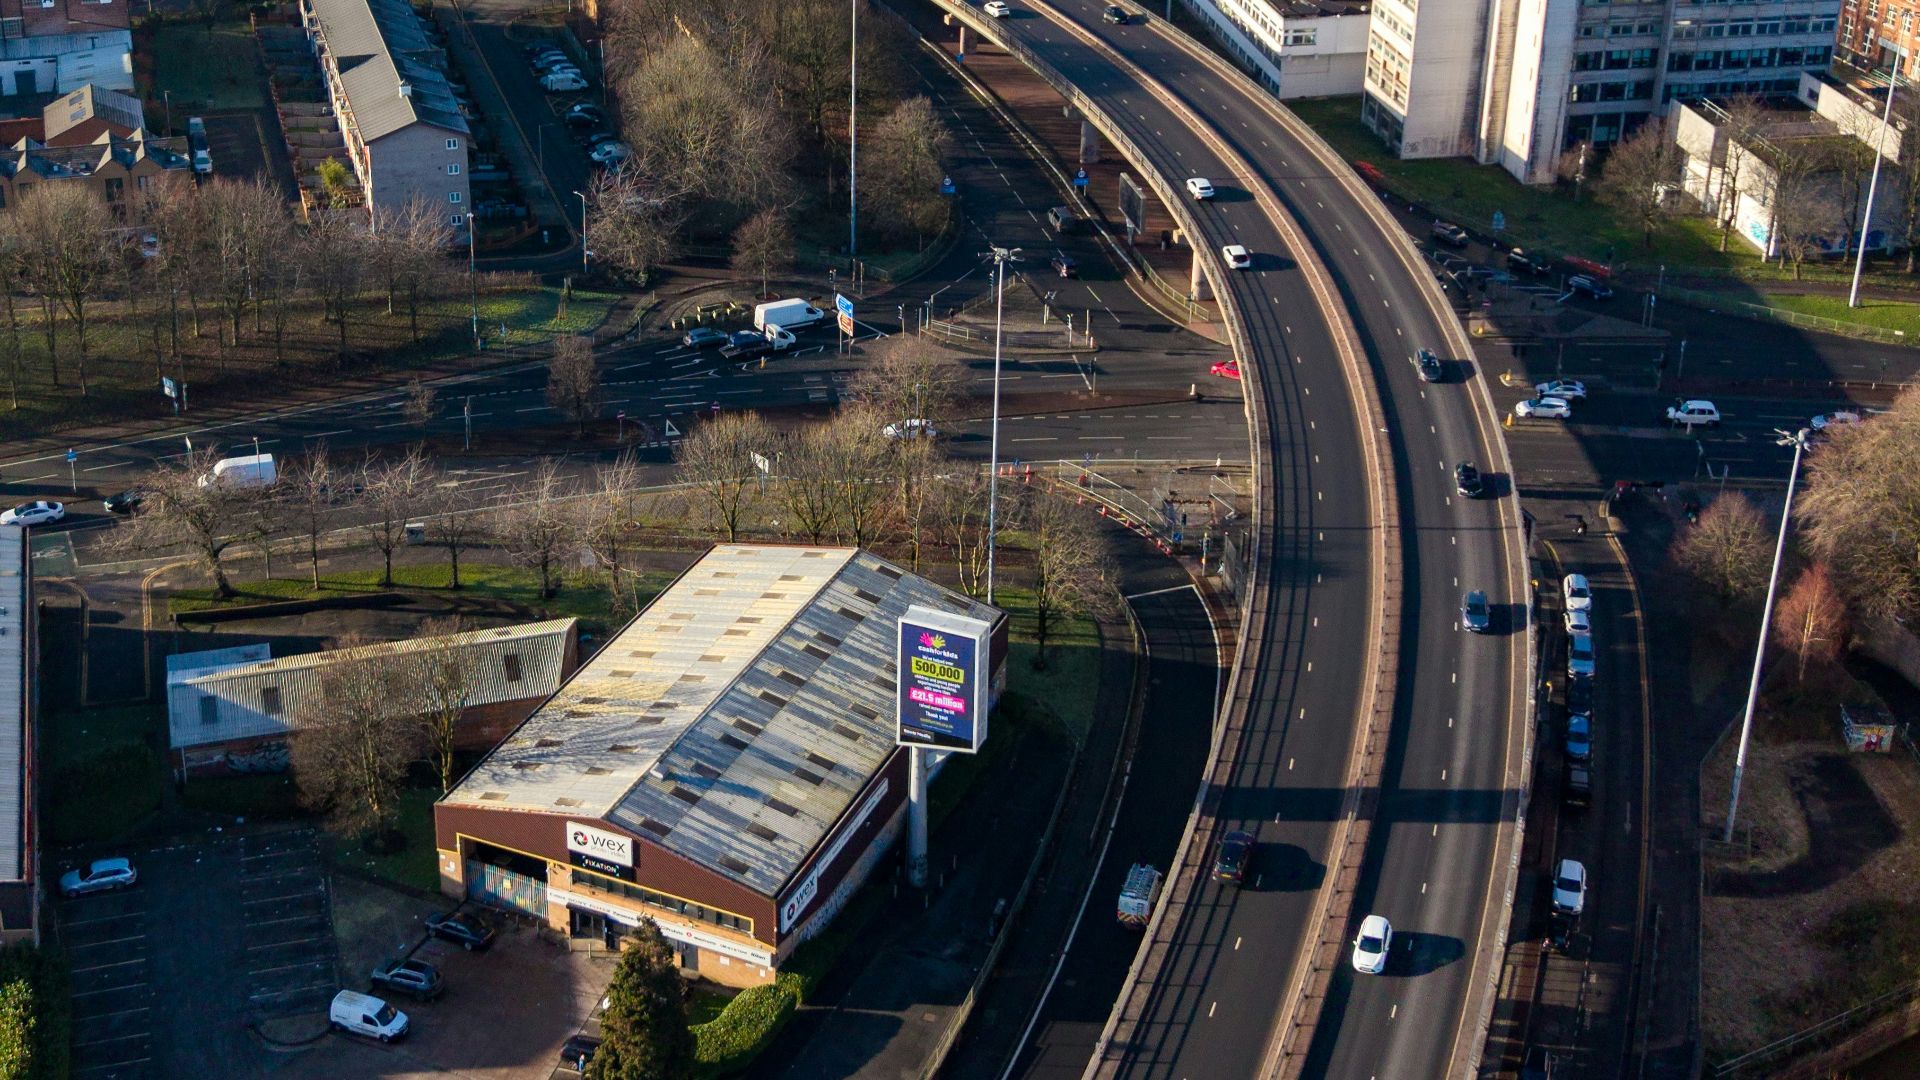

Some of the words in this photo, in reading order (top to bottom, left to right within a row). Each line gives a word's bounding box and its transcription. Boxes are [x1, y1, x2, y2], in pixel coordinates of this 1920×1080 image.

[915, 659, 960, 680] 500,000
[911, 689, 934, 702] £21.5
[934, 696, 963, 710] million
[591, 834, 625, 854] wex
[584, 859, 617, 873] FIXATION
[796, 876, 815, 905] wex
